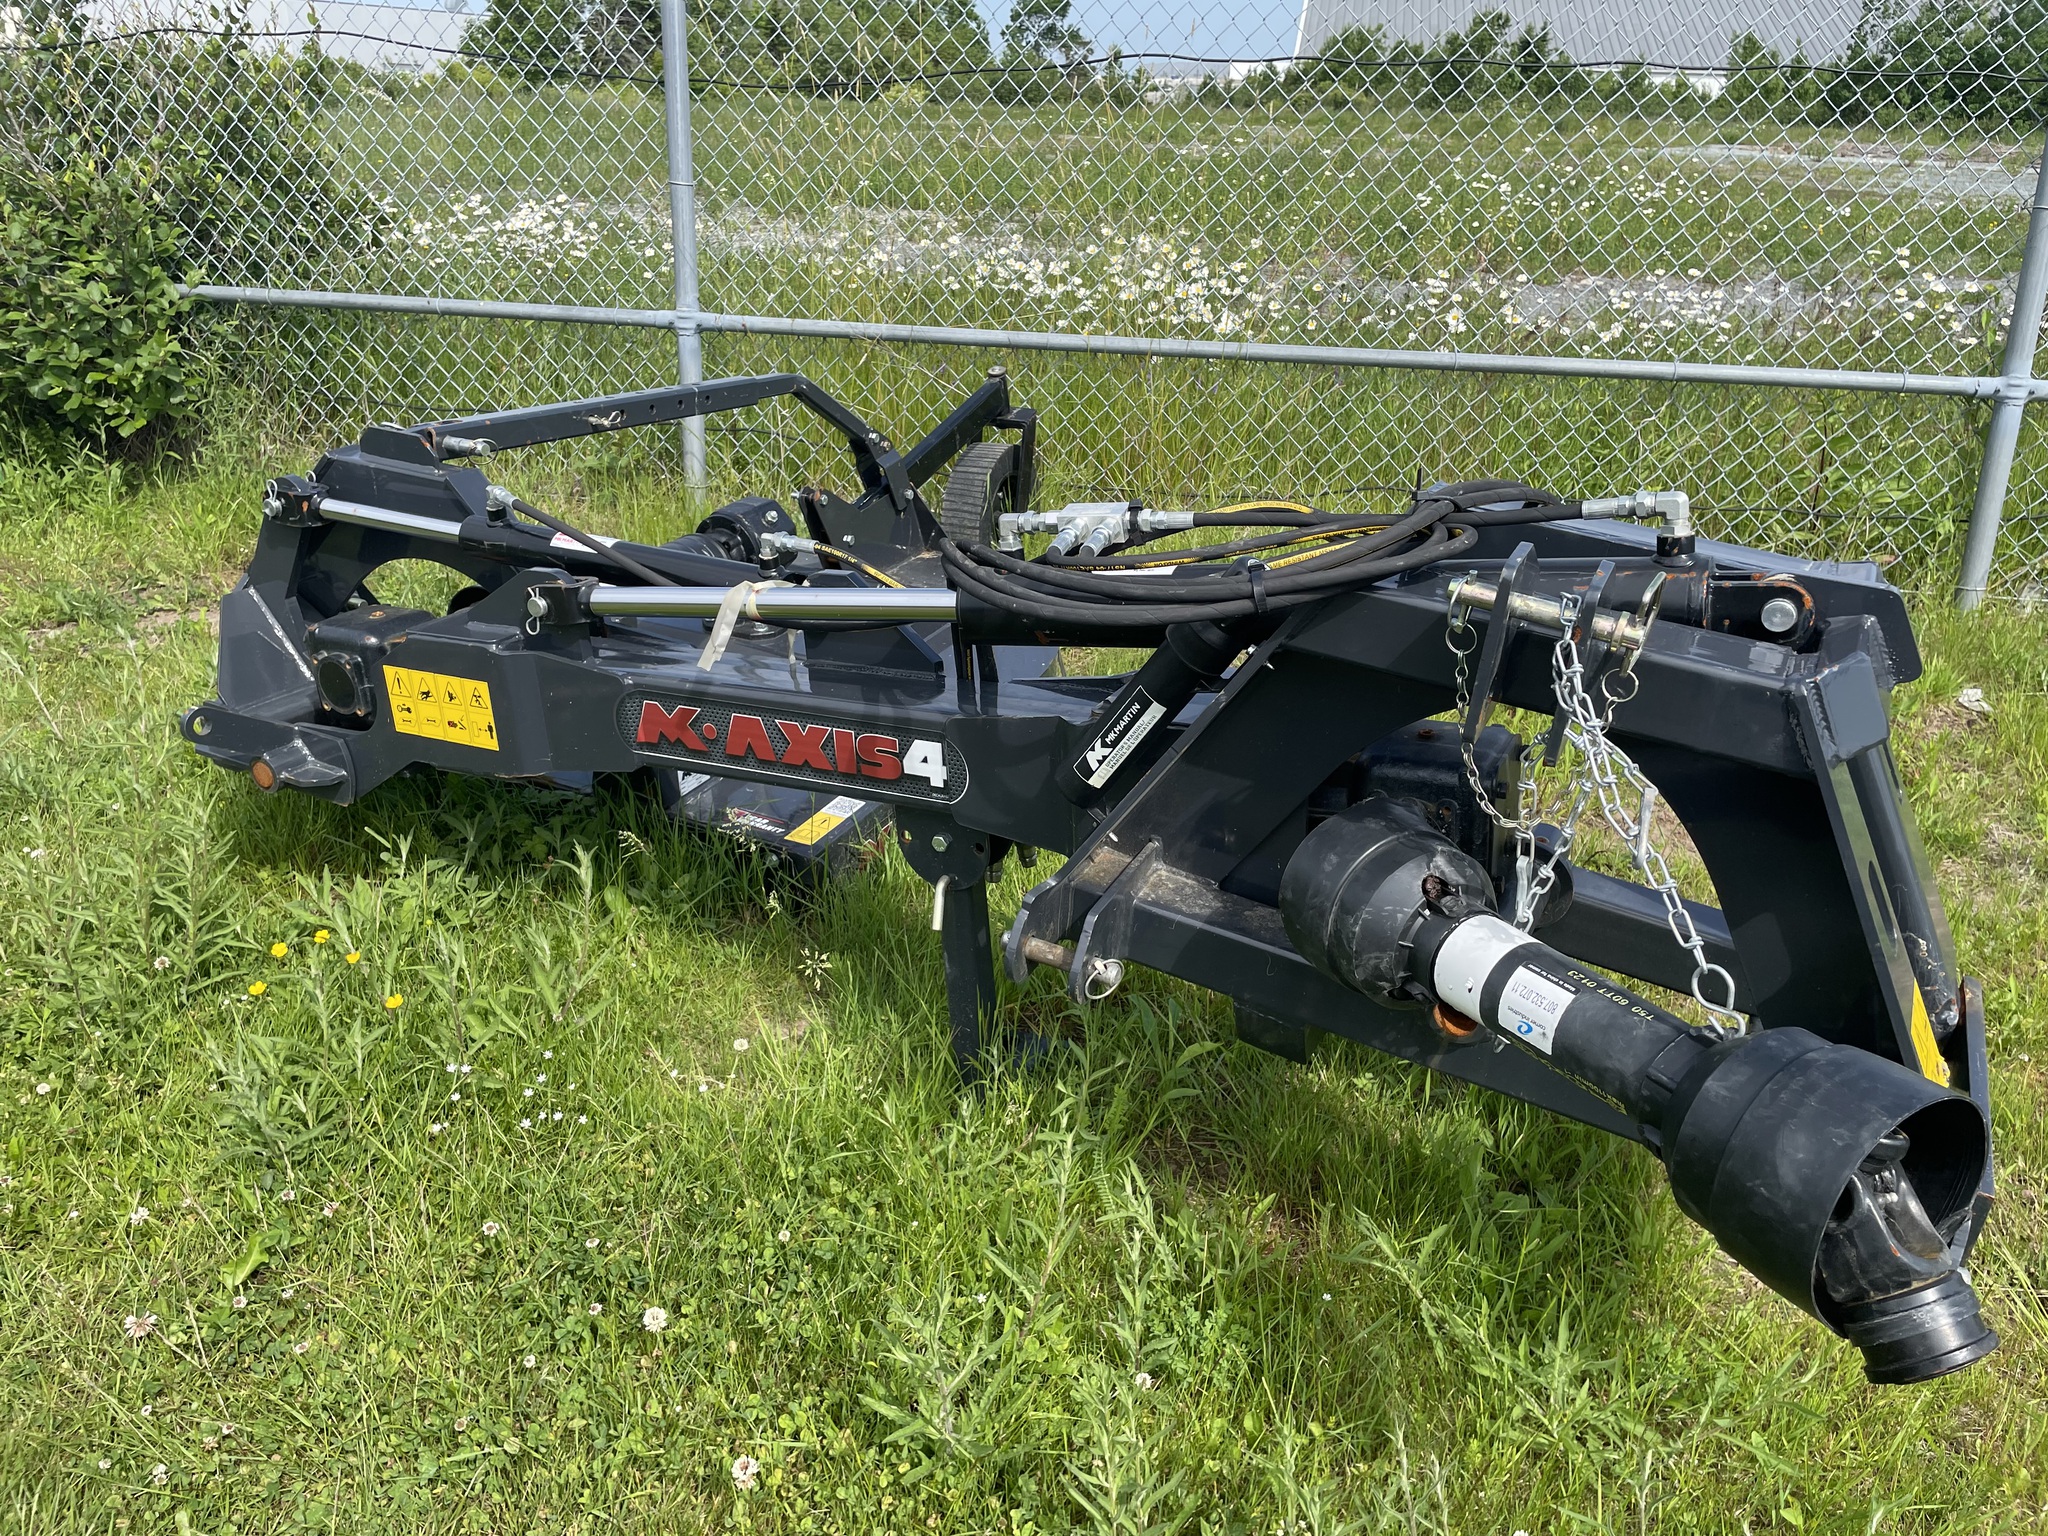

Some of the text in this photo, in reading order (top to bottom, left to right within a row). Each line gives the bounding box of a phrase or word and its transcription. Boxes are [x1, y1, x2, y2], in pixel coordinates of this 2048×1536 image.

[1282, 551, 1317, 565] RESISTANT
[1104, 702, 1141, 745] MKMARTIN
[1567, 970, 1597, 988] 0123
[1511, 981, 1559, 1014] 807.532.072.11
[1507, 1005, 1530, 1022] industries
[1631, 1006, 1655, 1021] T50
